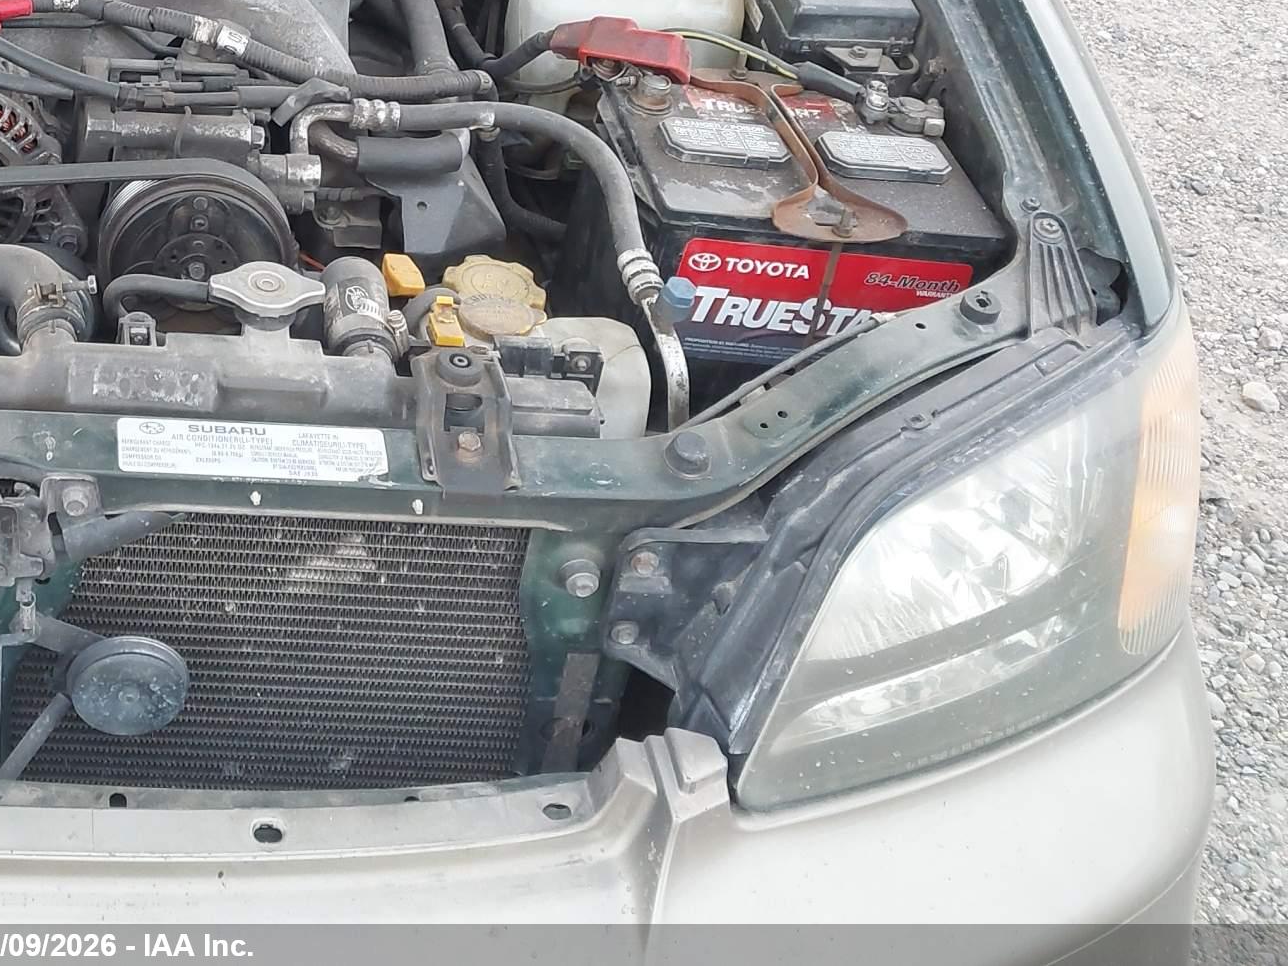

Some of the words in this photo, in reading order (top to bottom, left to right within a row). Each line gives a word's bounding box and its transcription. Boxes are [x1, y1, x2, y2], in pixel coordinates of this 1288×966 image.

[725, 257, 810, 280] TOYOTA
[864, 271, 961, 293] 84-Month
[188, 424, 266, 436] SUBARU
